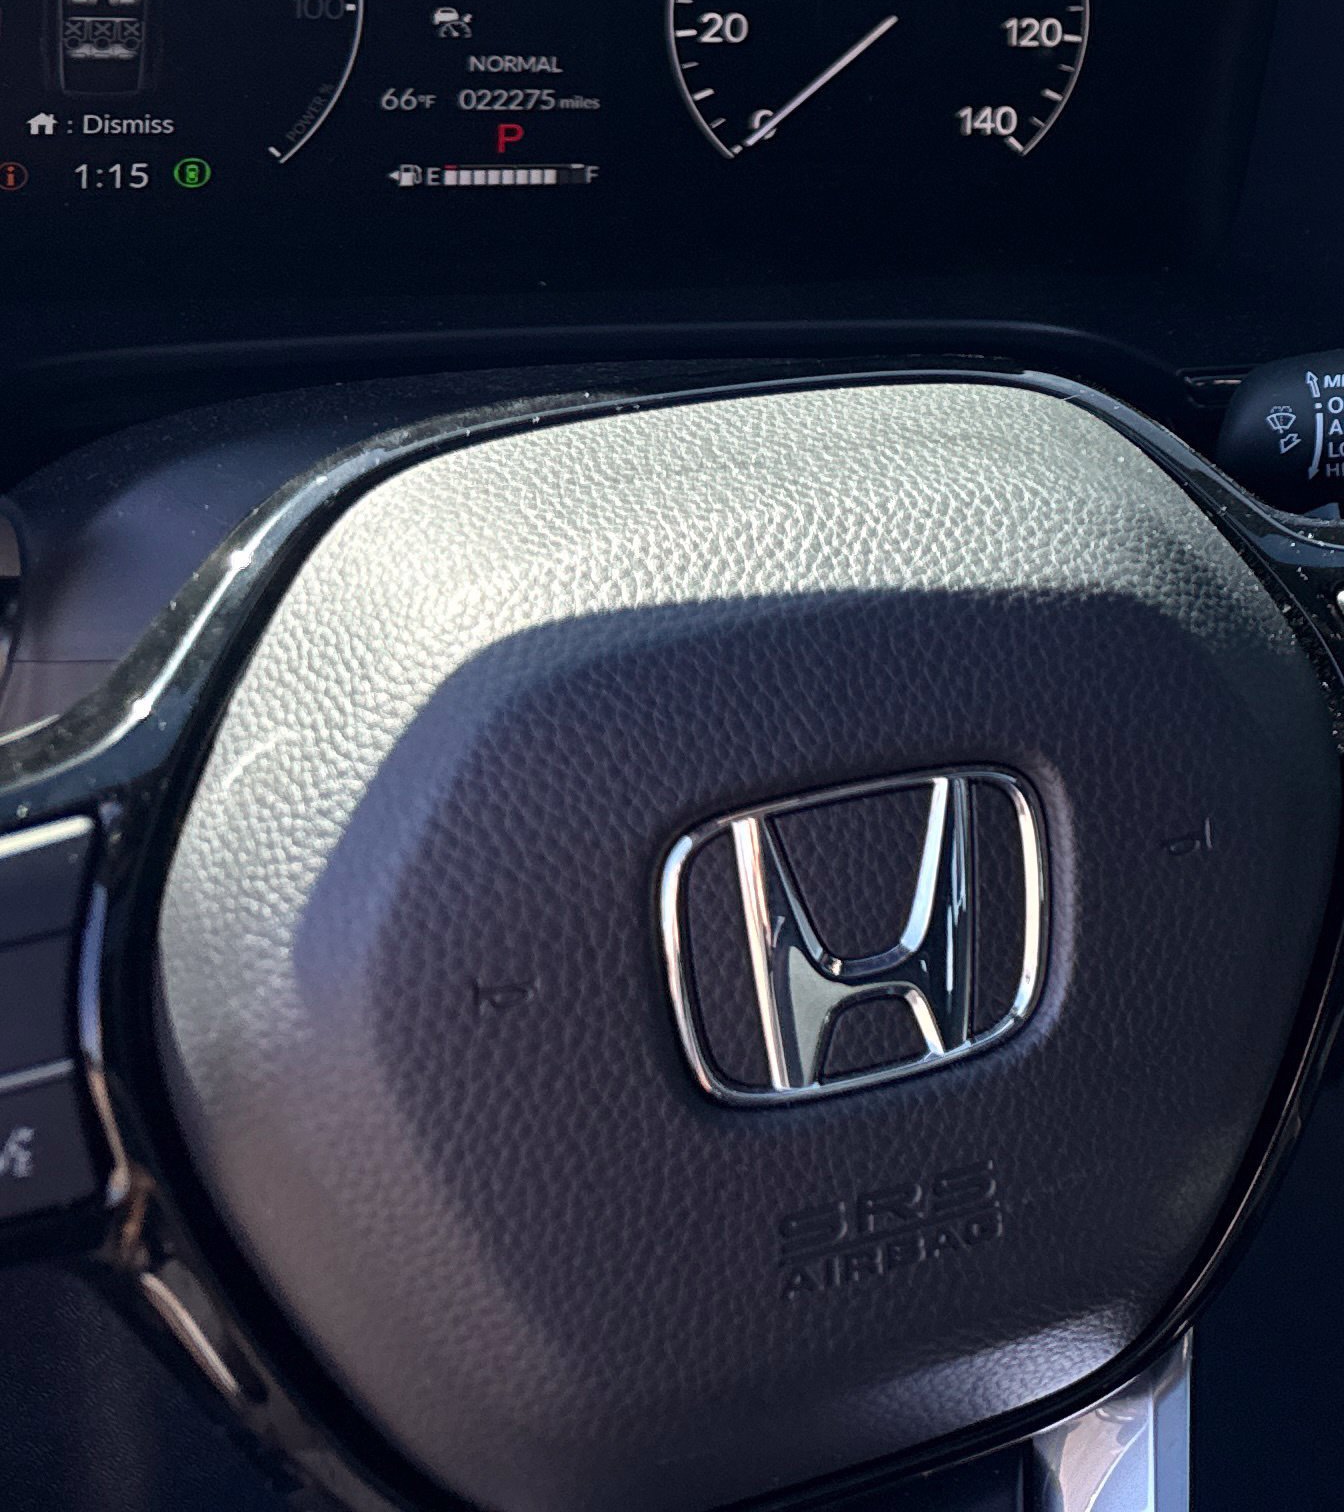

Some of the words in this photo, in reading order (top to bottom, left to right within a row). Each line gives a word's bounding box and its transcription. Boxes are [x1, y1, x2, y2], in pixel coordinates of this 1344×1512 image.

[699, 12, 749, 44] 20
[1003, 17, 1064, 48] 120
[469, 54, 563, 74] NORMAL
[458, 88, 556, 111] 022275
[559, 91, 601, 110] miles
[82, 112, 175, 136] Dismiss
[285, 95, 328, 143] POWER
[955, 105, 1018, 137] 140
[496, 123, 524, 153] P
[73, 163, 150, 190] 1:15
[426, 166, 441, 185] E
[586, 166, 600, 183] F
[778, 1158, 998, 1256] SRS
[781, 1210, 1004, 1301] AIRBAG
